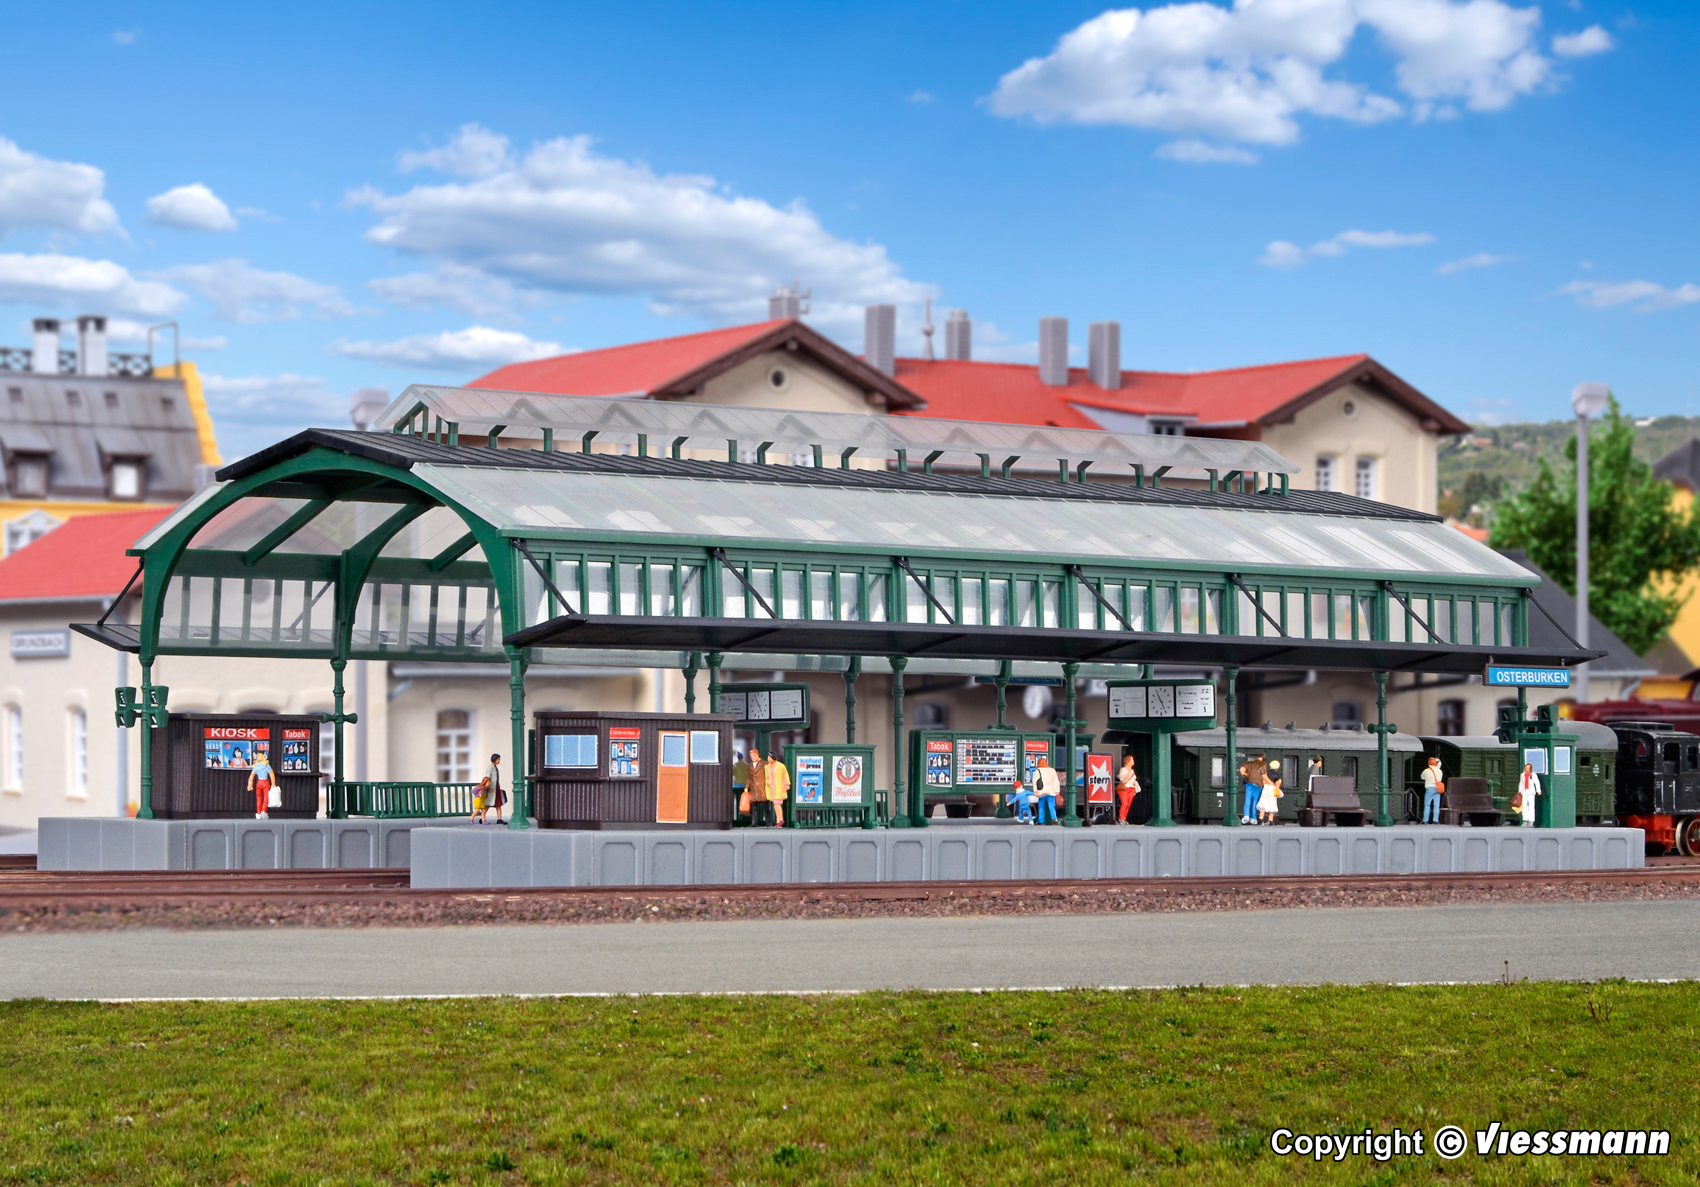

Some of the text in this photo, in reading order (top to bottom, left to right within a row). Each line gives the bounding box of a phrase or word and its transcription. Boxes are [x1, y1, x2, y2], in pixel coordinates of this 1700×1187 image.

[1496, 671, 1568, 683] OSTERBURKEN
[211, 728, 257, 738] KIOSK
[284, 730, 306, 738] Tabak
[929, 742, 949, 750] Tabak
[1089, 775, 1111, 784] stern
[1217, 799, 1223, 808] 2
